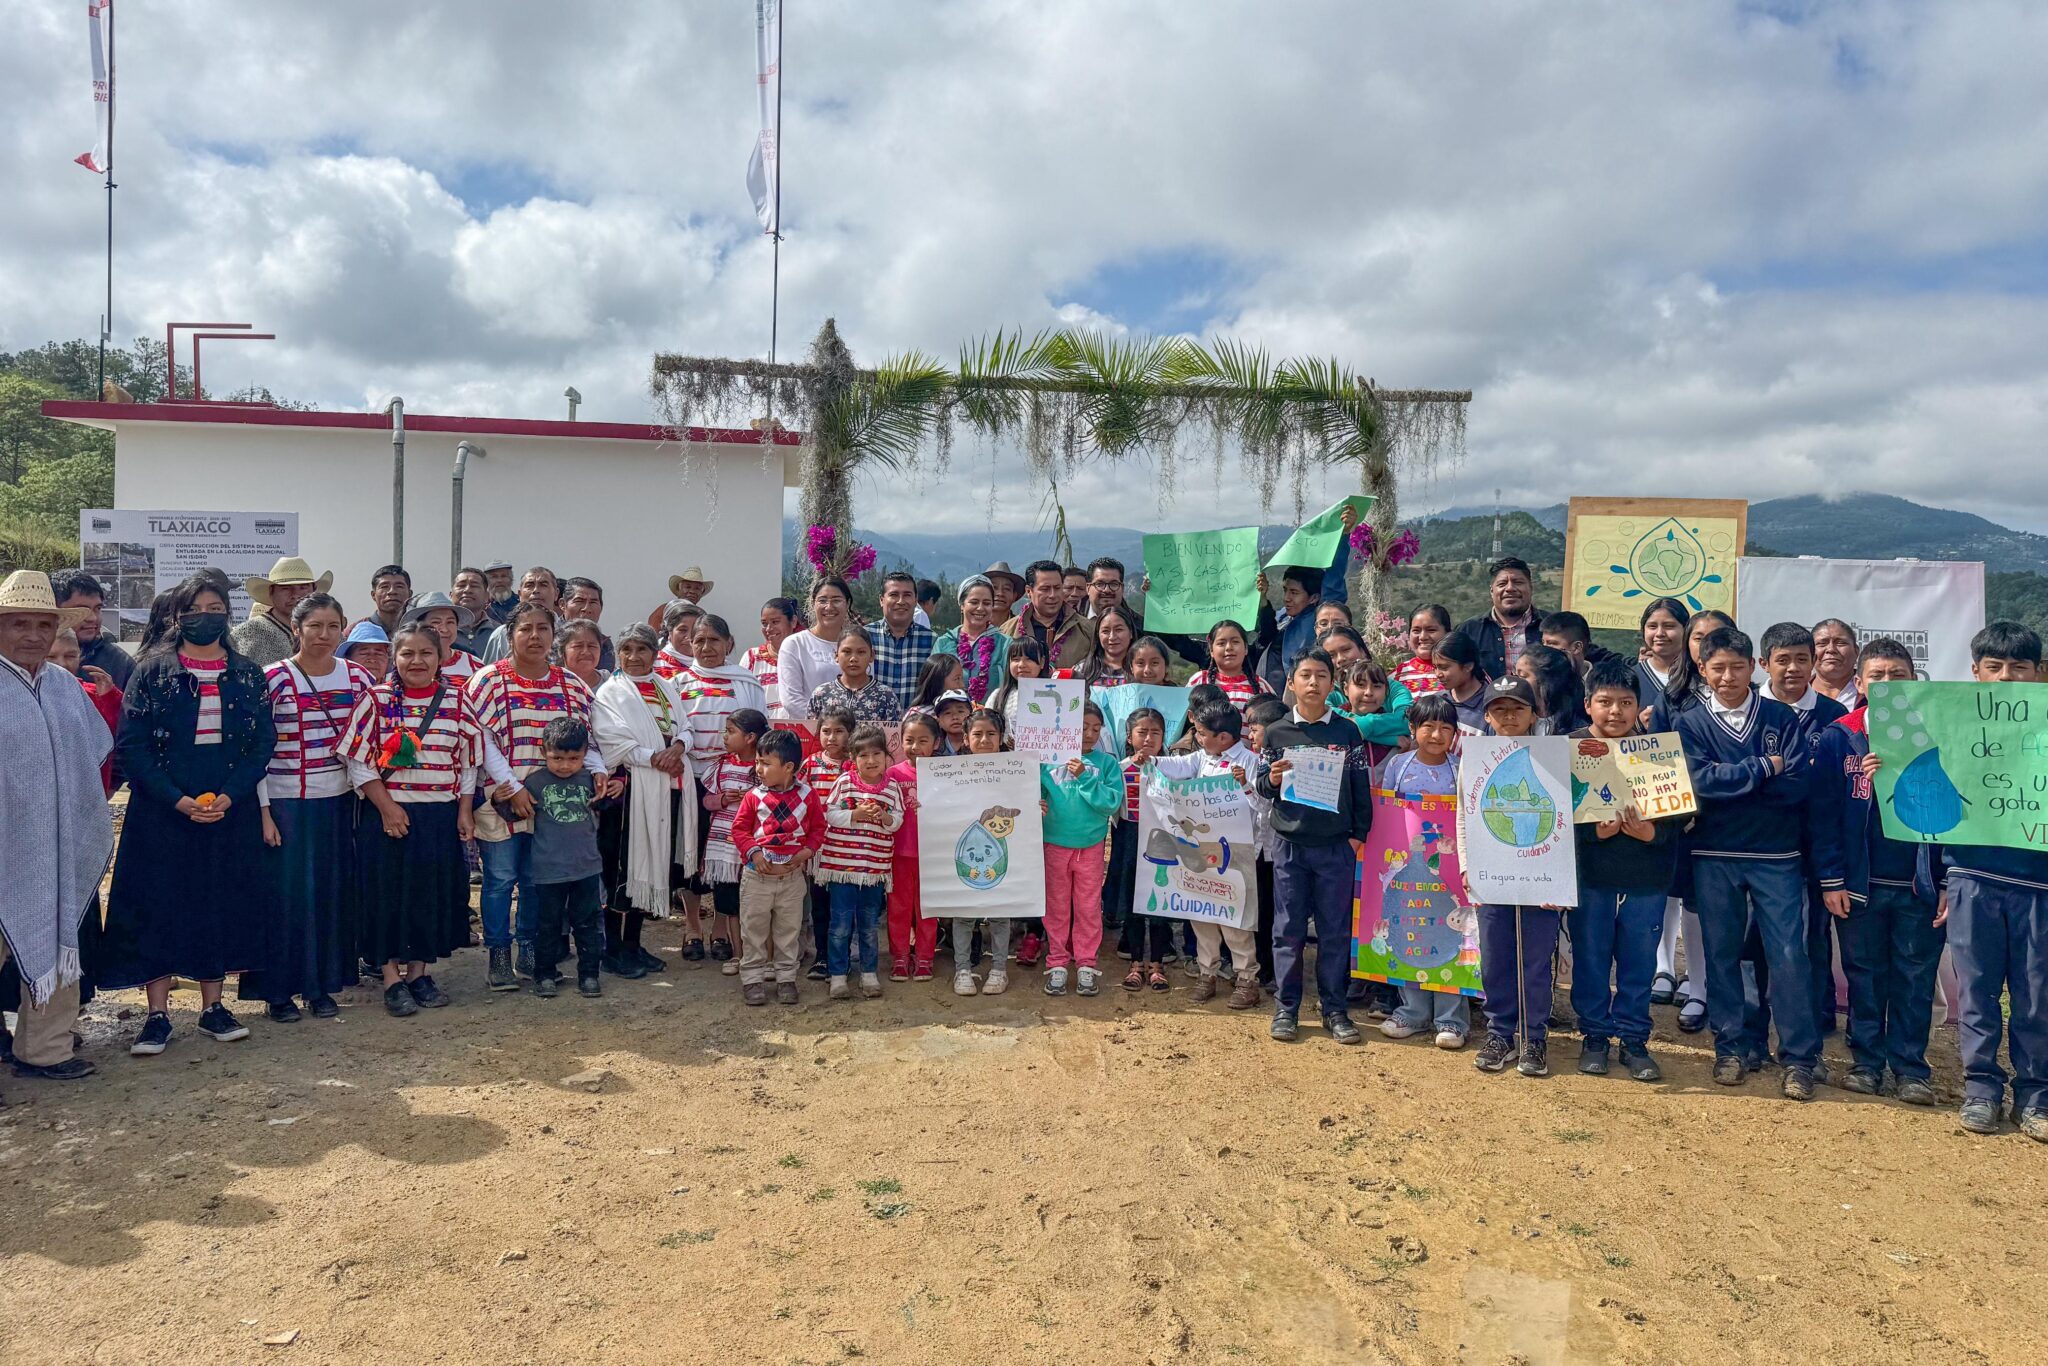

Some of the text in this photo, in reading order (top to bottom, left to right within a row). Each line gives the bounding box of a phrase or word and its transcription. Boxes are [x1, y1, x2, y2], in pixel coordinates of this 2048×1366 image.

[148, 521, 231, 533] TLAXIACO
[1163, 541, 1242, 557] BIENVENIDO
[1155, 563, 1231, 579] A SU CASA
[1977, 692, 2029, 722] Una
[1016, 726, 1037, 734] TOMAR
[1620, 737, 1659, 754] CUIDA
[1971, 727, 2004, 759] de
[929, 762, 953, 770] Cuidar
[1007, 759, 1023, 767] hoy
[1629, 750, 1680, 765] EL AGUA
[954, 776, 1001, 785] sostenible
[1466, 741, 1519, 815] Cuidemos el futuro
[1626, 771, 1676, 787] SIN AGUA
[1983, 773, 2013, 789] es
[1632, 782, 1678, 798] NO HAY
[1852, 774, 1870, 800] 19
[1186, 799, 1200, 807] no
[1203, 793, 1221, 805] has
[1225, 791, 1238, 802] de
[1393, 799, 1414, 810] AGUA
[1421, 801, 1437, 811] ES
[1442, 802, 1457, 811] VI
[1636, 792, 1693, 816] VIDA
[1989, 787, 2040, 817] gota
[1204, 807, 1239, 819] beber
[1517, 811, 1566, 857] cuidando el agua
[1390, 880, 1447, 892] CUIDEMOS
[1479, 871, 1488, 881] El
[1491, 875, 1515, 886] agua
[1533, 873, 1552, 882] vida
[1401, 898, 1432, 908] CADA
[1406, 946, 1438, 956] AGUA
